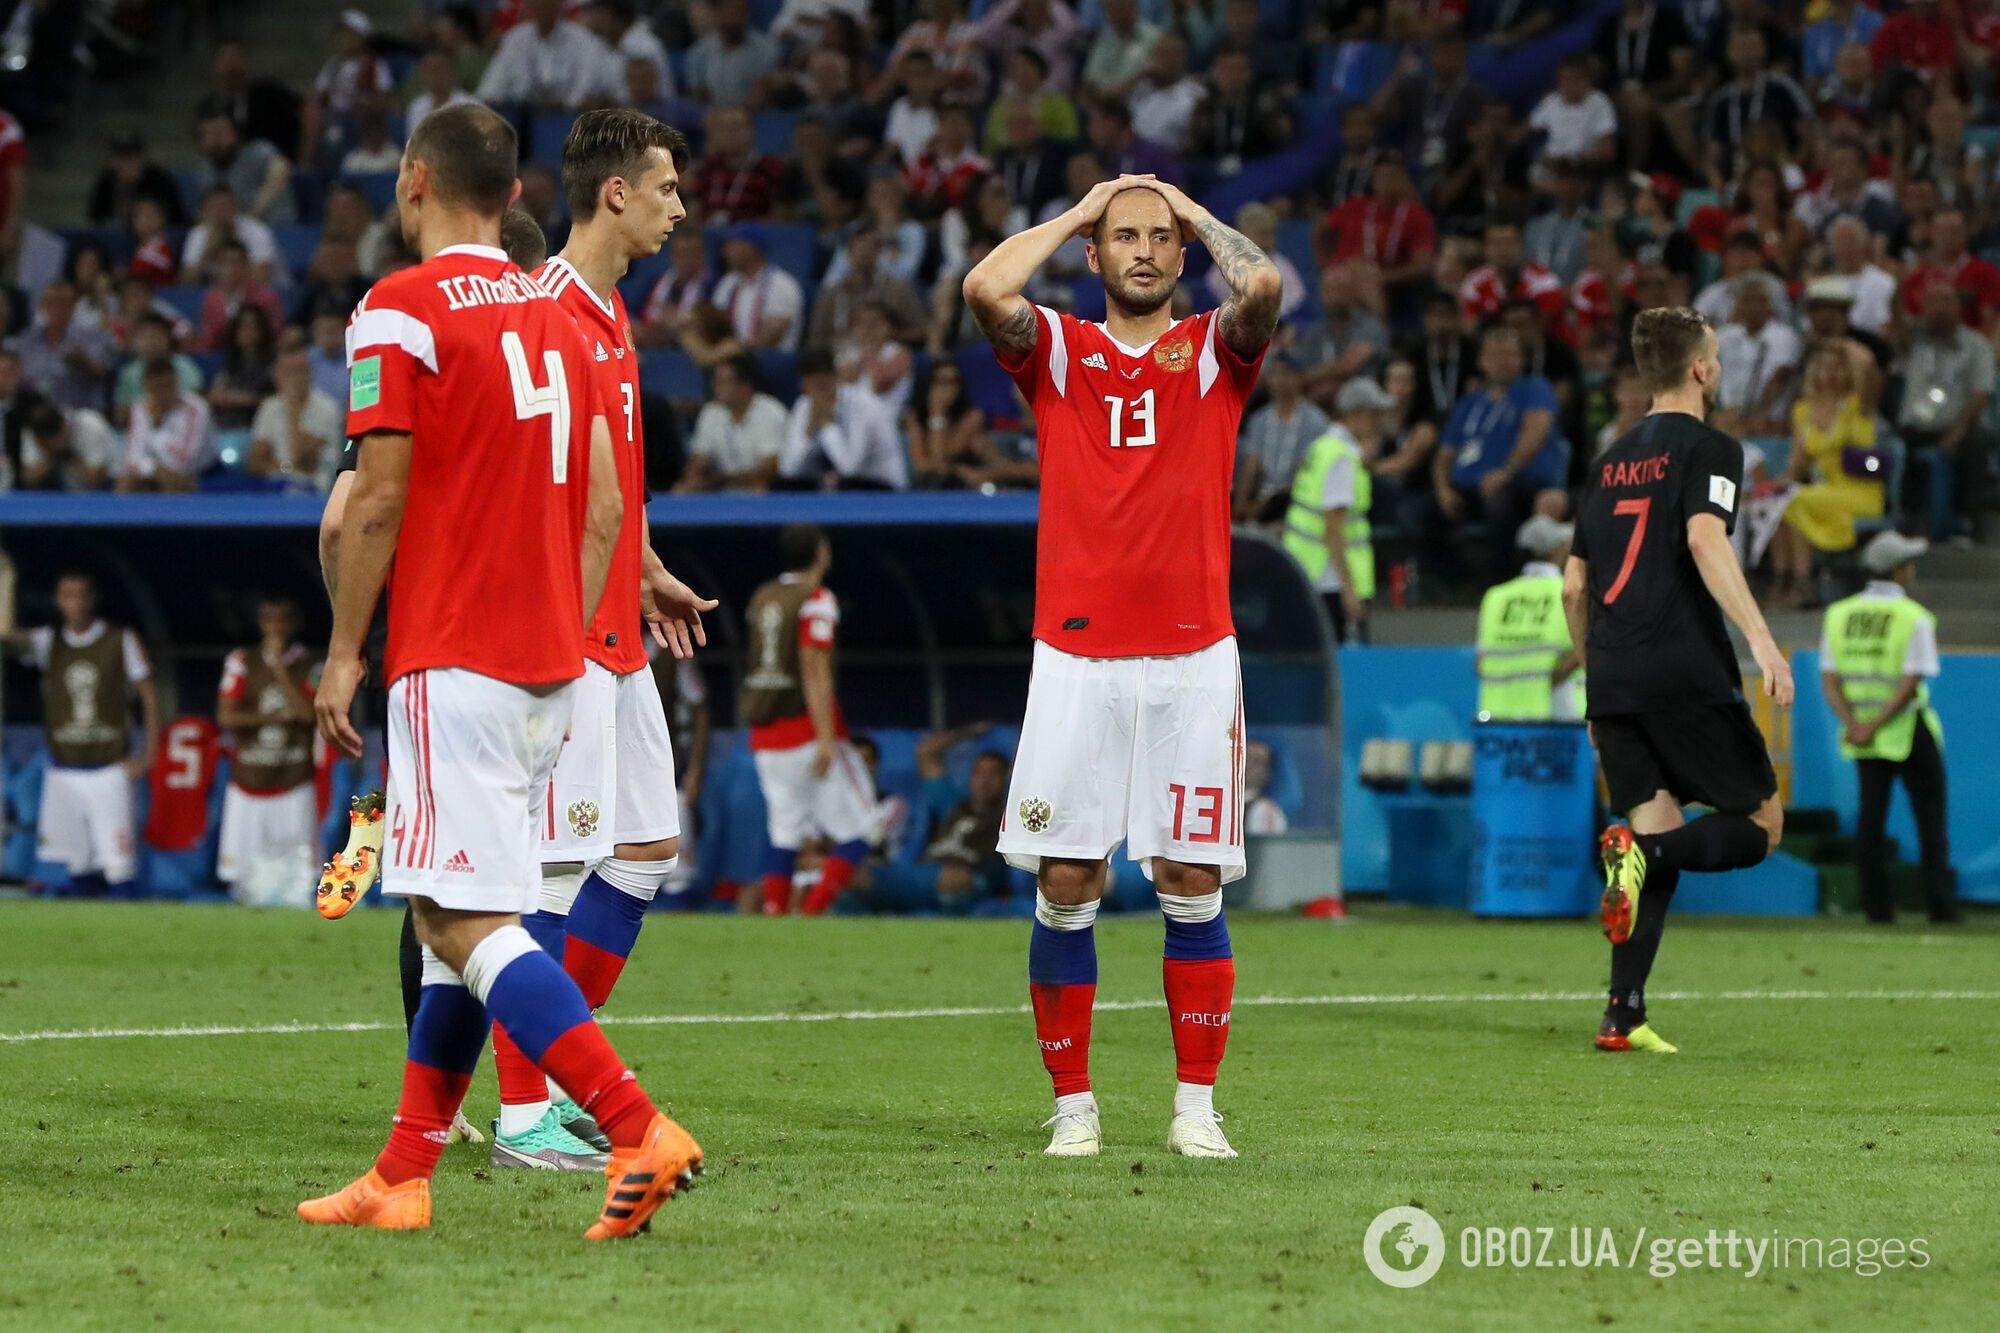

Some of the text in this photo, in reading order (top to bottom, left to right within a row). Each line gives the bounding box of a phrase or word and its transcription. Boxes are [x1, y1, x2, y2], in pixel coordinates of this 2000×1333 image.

[501, 331, 571, 485] 4
[1104, 388, 1156, 447] 13
[1603, 497, 1651, 605] 7
[166, 724, 202, 789] 5
[392, 804, 406, 867] 4
[1169, 783, 1224, 844] 13
[442, 863, 475, 873] adidas
